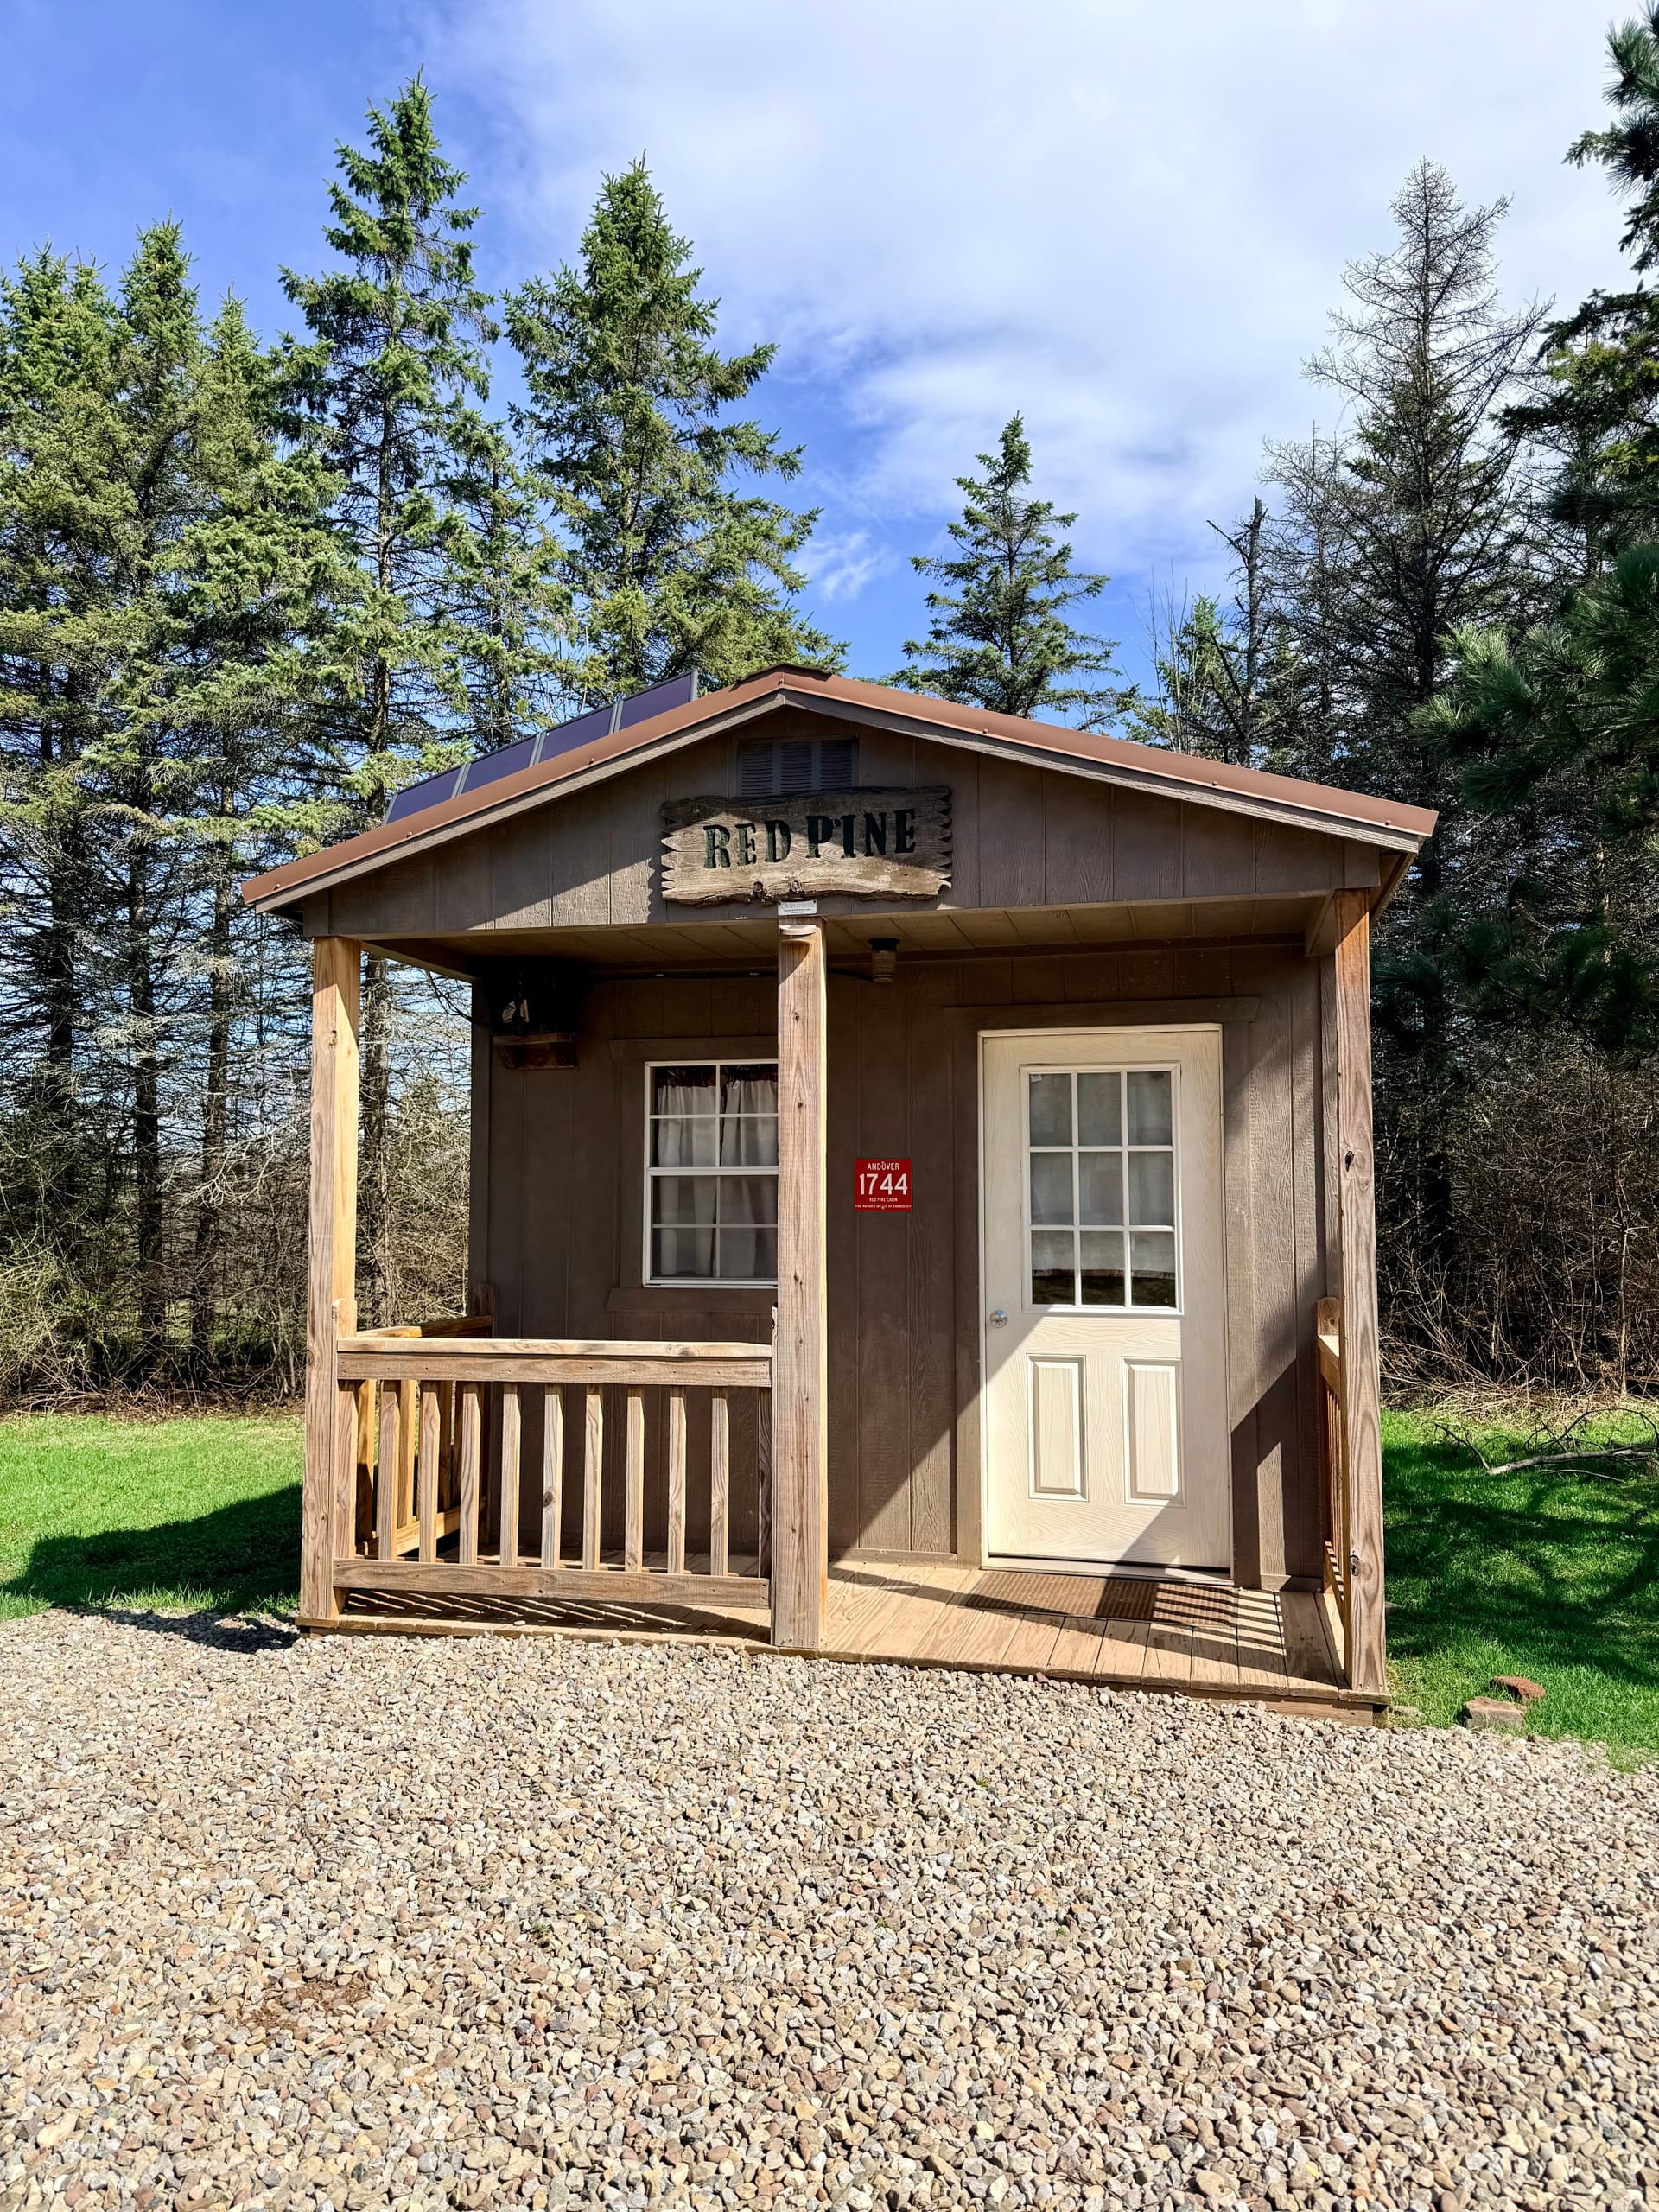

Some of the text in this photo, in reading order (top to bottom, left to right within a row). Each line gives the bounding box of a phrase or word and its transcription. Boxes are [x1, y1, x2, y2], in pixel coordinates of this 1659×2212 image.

[702, 808, 917, 869] RED PINE
[867, 1161, 899, 1171] ANDOVER
[859, 1173, 908, 1195] 1744
